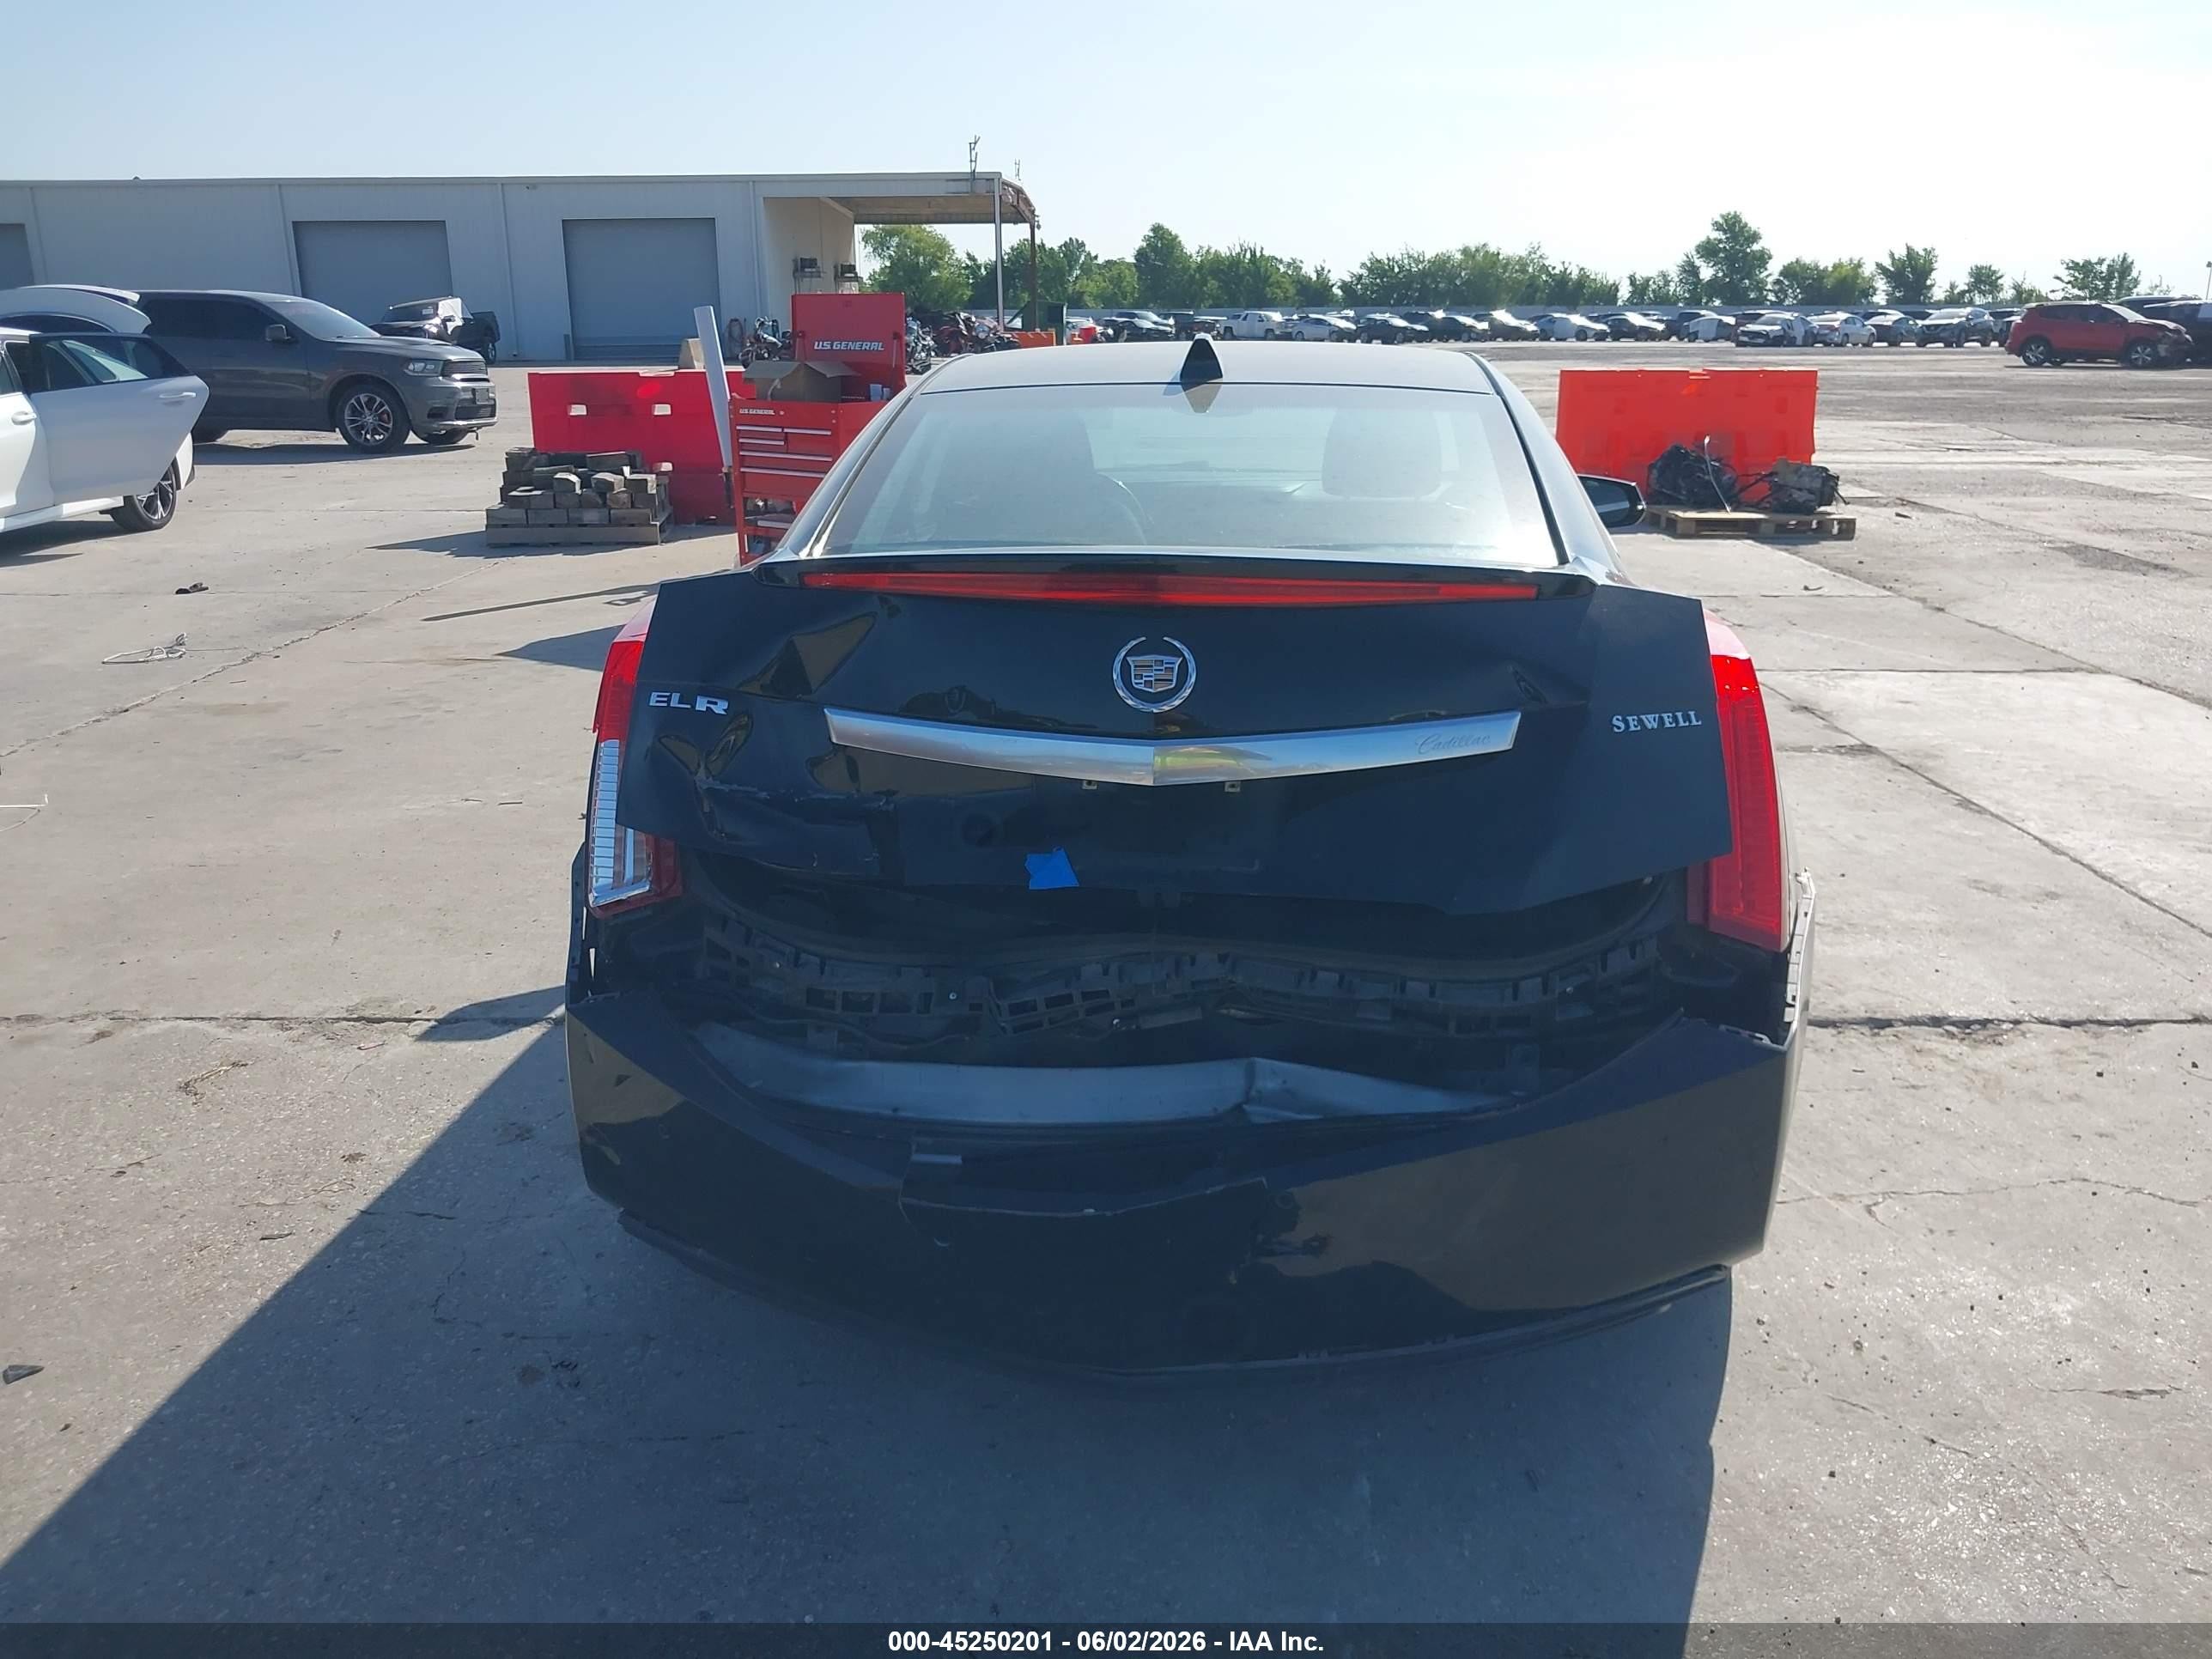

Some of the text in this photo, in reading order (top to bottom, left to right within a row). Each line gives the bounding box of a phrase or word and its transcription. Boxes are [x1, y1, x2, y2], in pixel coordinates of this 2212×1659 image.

[832, 341, 884, 351] GENERAL
[1612, 710, 1702, 732] SEWELL
[1415, 734, 1491, 755] Cadillac
